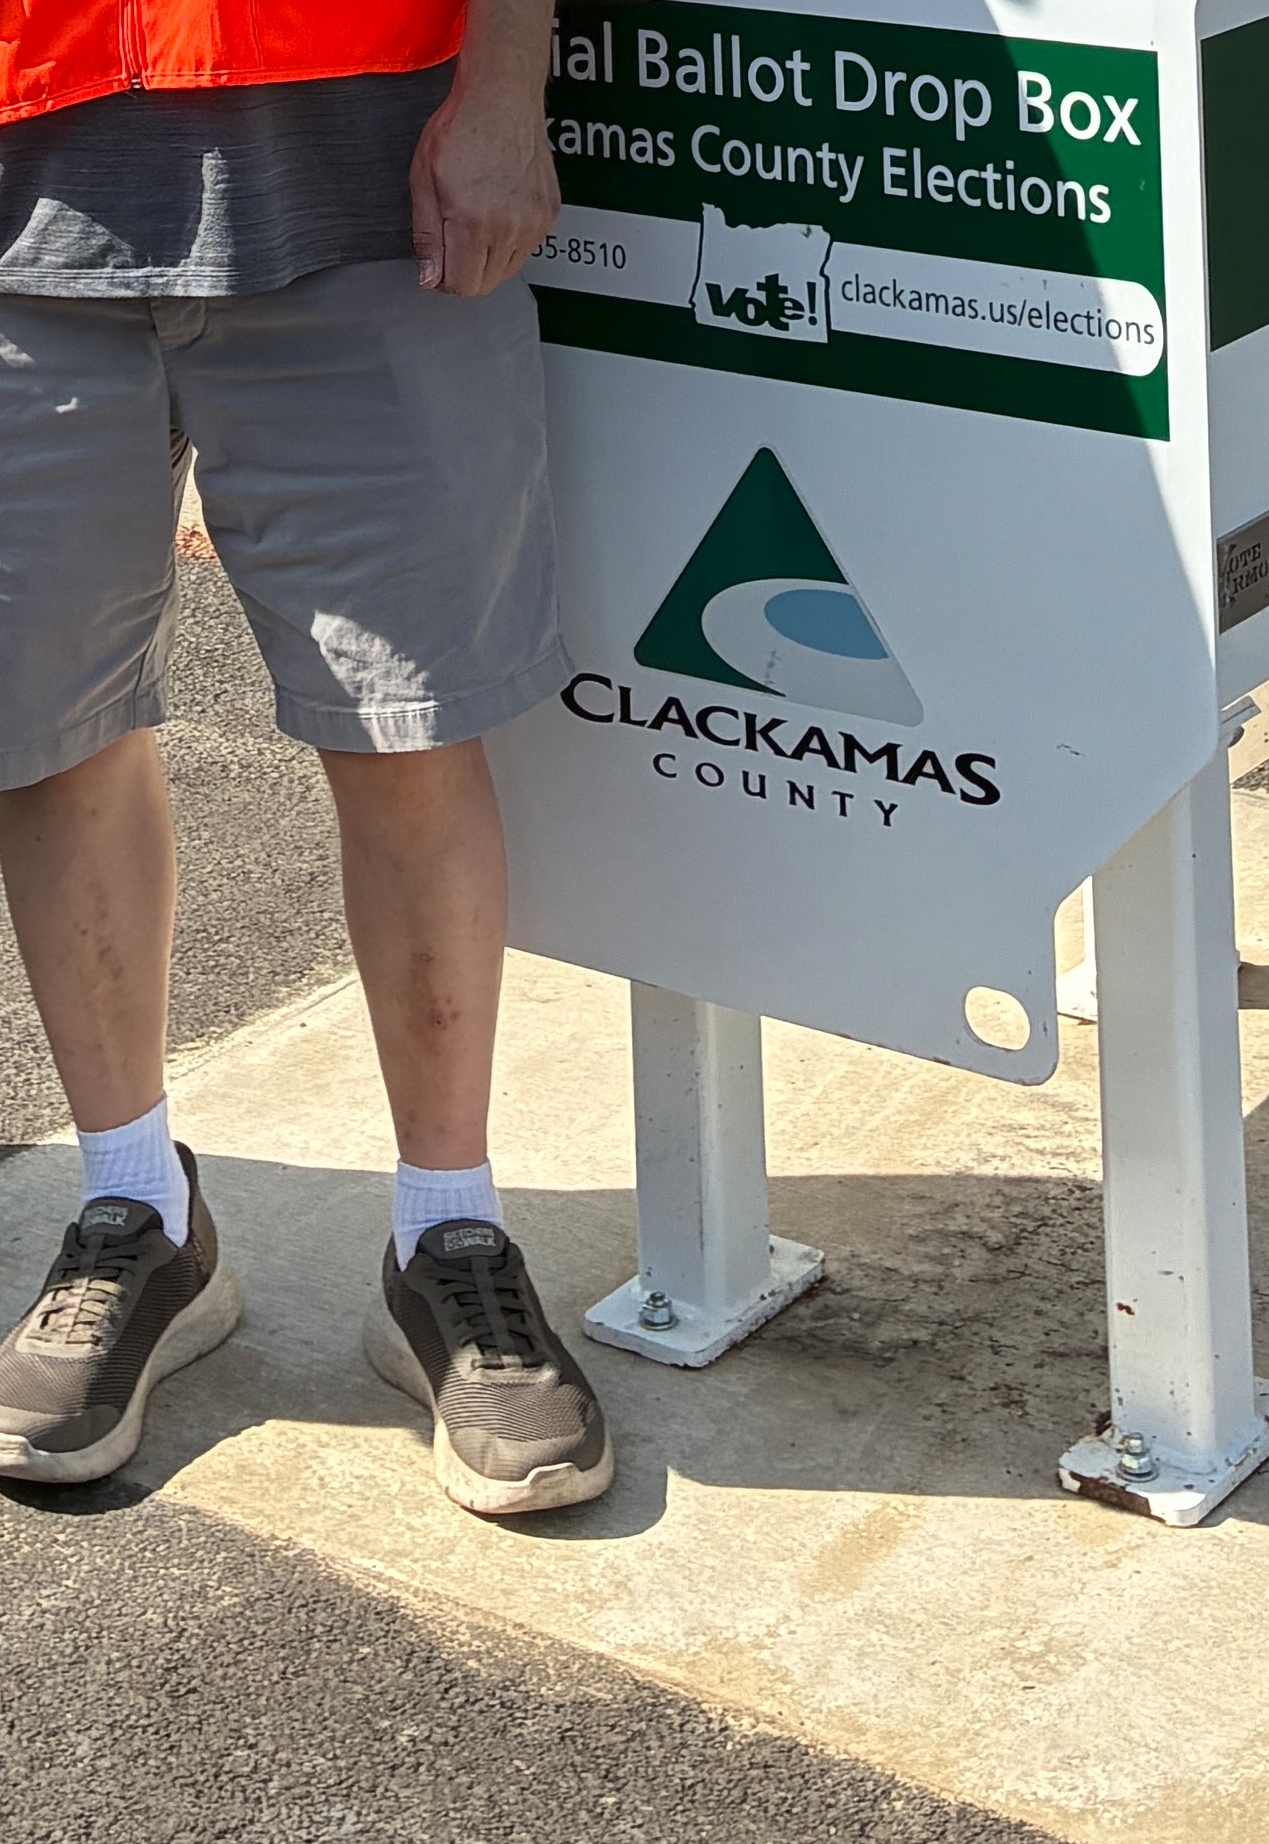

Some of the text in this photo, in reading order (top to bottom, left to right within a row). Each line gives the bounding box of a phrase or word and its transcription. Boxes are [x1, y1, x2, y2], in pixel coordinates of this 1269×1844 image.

[551, 17, 1142, 146] ial Ballot Drop Box
[691, 124, 865, 203] County
[883, 146, 1113, 224] Elections
[840, 271, 1156, 346] clackamas.us/elections
[1227, 543, 1262, 574] OTE
[559, 672, 1002, 806] CLACKAMAS
[652, 752, 899, 827] COUNTY
